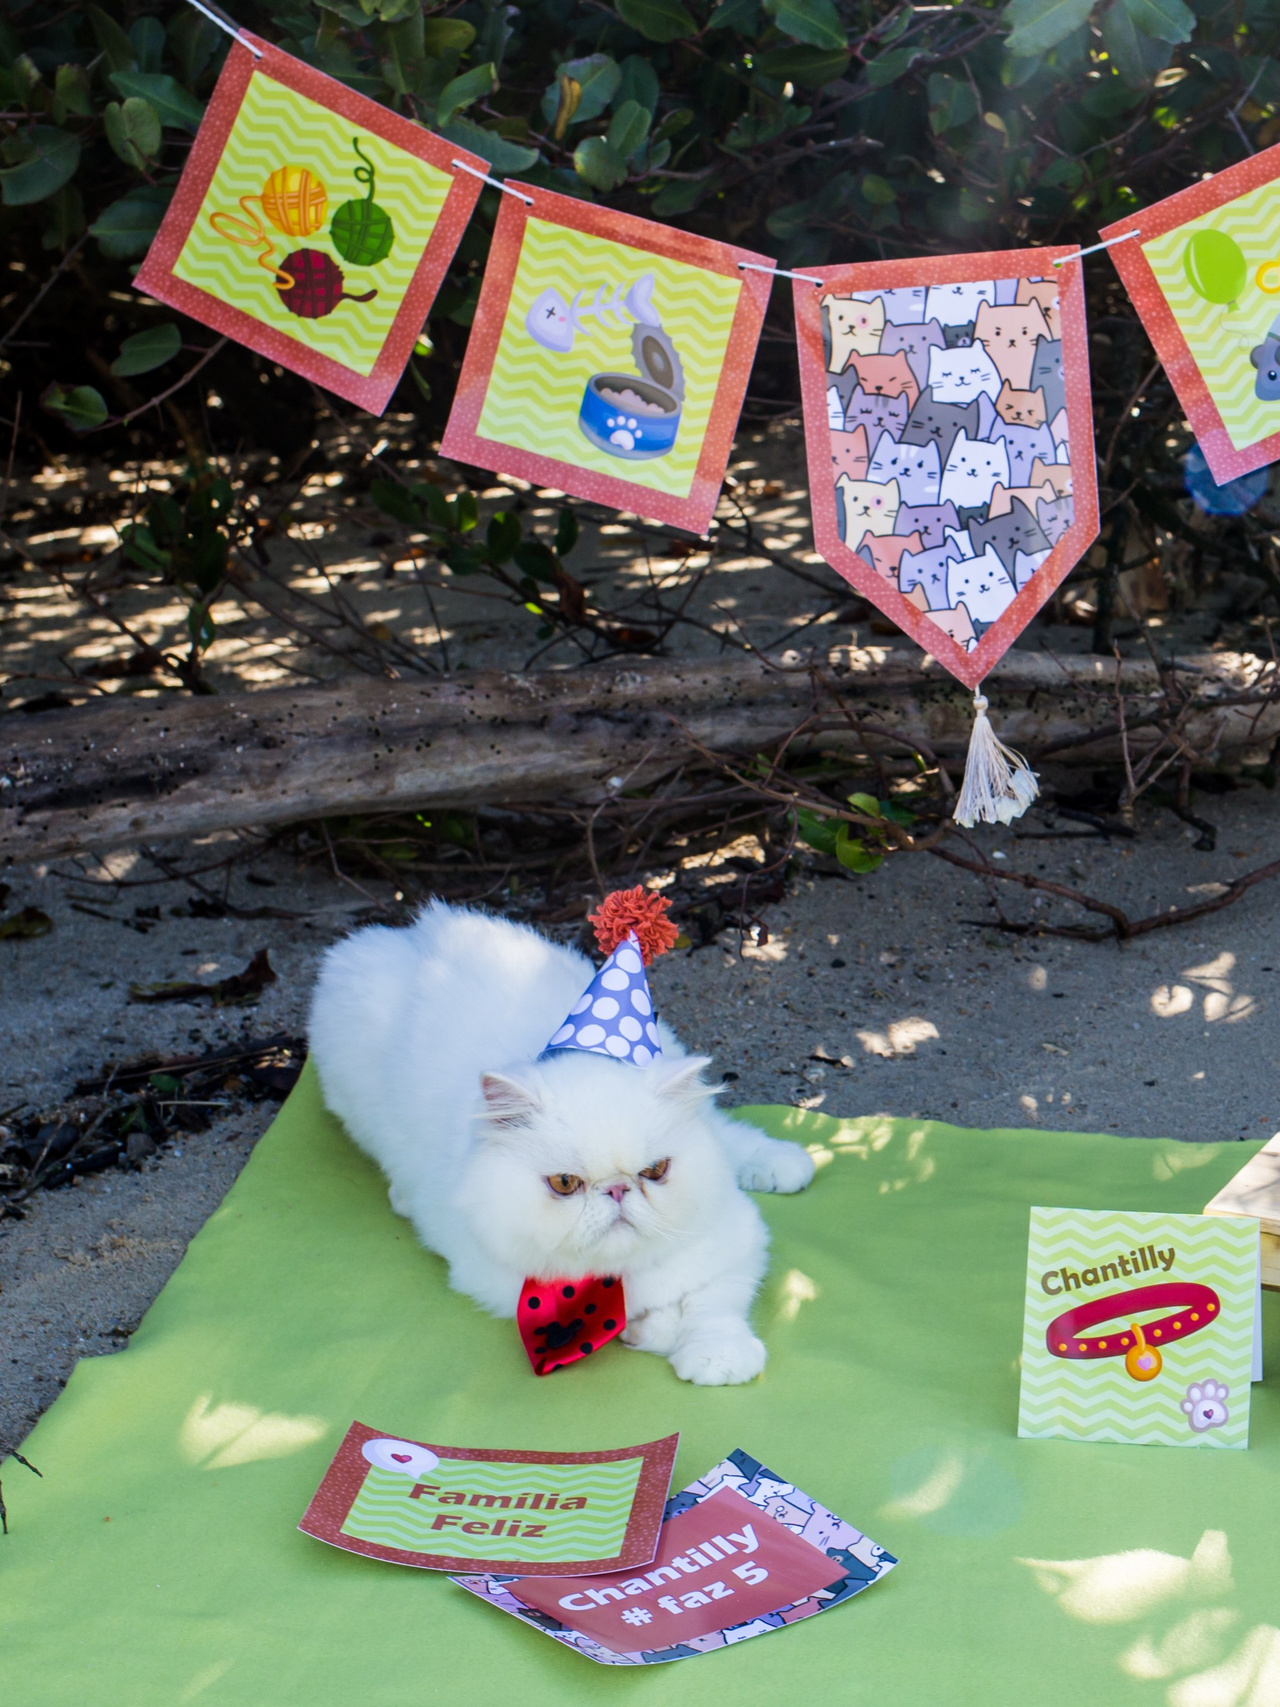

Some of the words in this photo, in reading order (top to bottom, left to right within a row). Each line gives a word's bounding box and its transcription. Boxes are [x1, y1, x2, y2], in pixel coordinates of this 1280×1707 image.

[1041, 1245, 1175, 1295] Chantilly
[408, 1482, 588, 1510] Família
[430, 1513, 548, 1539] Feliz
[558, 1523, 760, 1611] Chantilly
[620, 1606, 654, 1627] #
[657, 1580, 735, 1615] faz
[731, 1560, 770, 1586] 5
